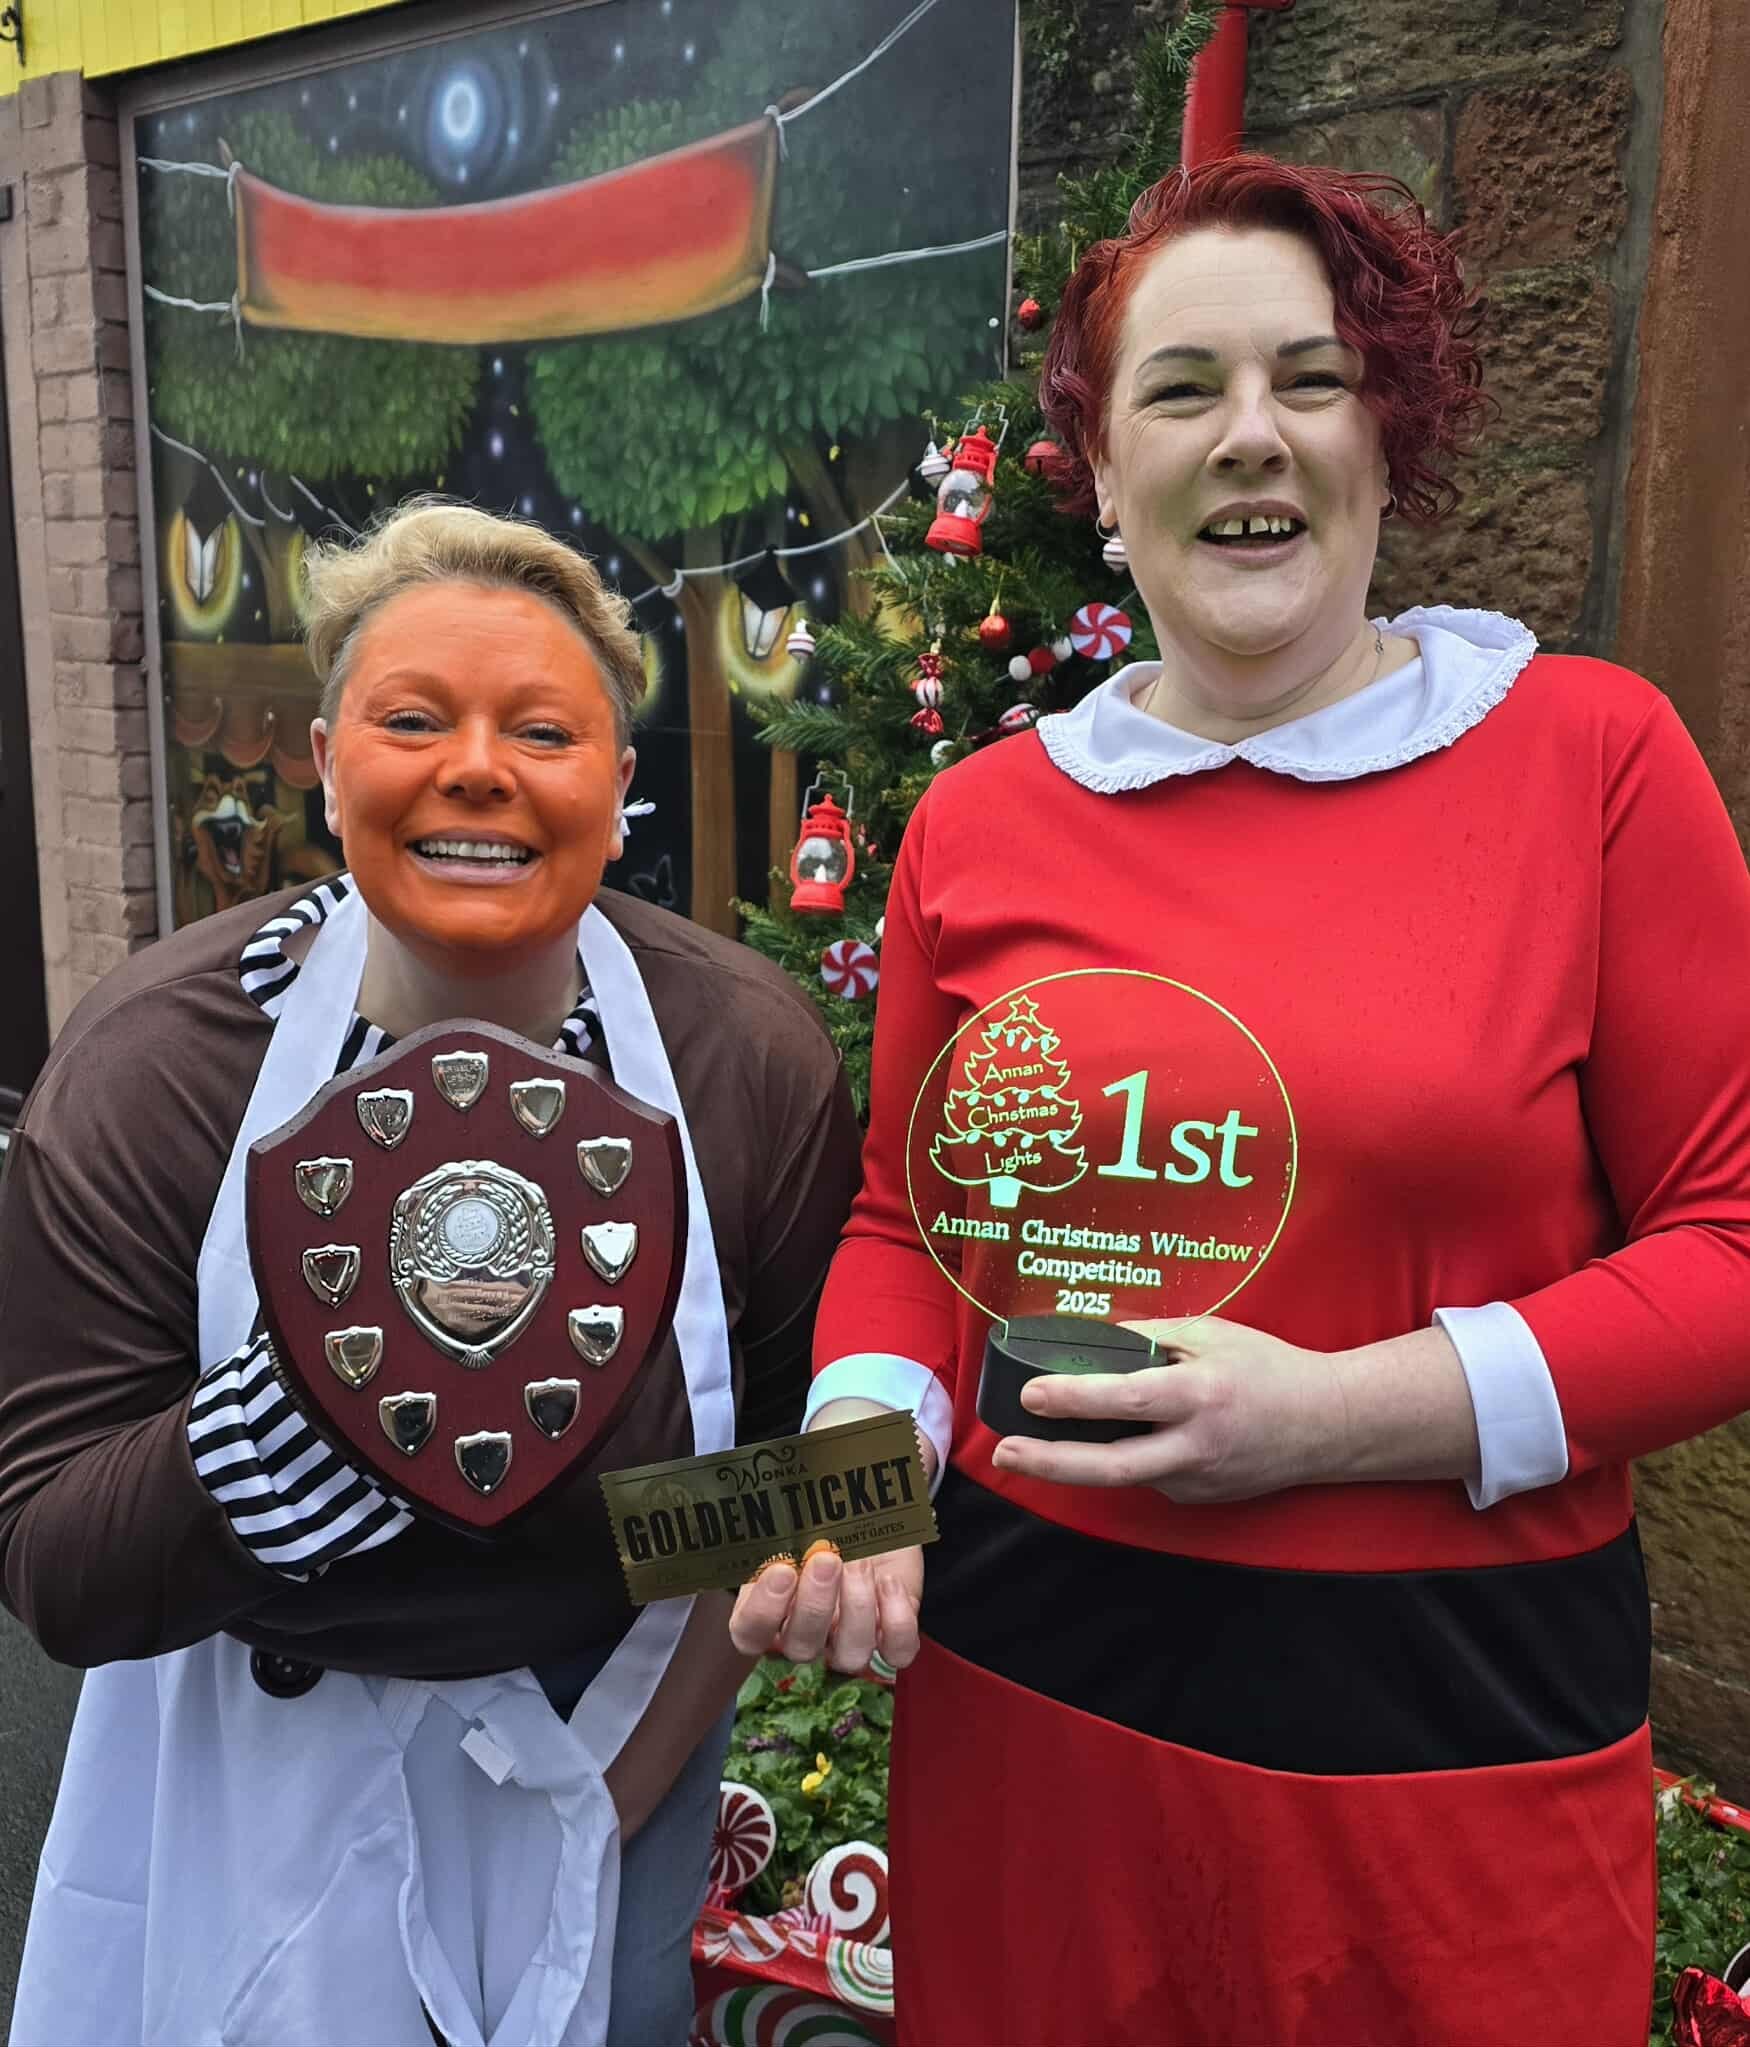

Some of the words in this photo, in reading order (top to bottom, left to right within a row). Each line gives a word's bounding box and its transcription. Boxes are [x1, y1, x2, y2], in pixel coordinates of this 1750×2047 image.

[982, 1061, 1044, 1086] Annan
[967, 1102, 1059, 1130] Christmas
[1097, 1070, 1259, 1188] 1st
[985, 1148, 1042, 1176] Lights
[930, 1211, 1011, 1242] Annan
[1021, 1219, 1142, 1254] Christmas
[1151, 1231, 1254, 1263] Window
[1017, 1251, 1162, 1287] Competition
[1056, 1289, 1112, 1316] 2025
[623, 1489, 777, 1562] GOLDEN
[782, 1456, 915, 1531] TICKET
